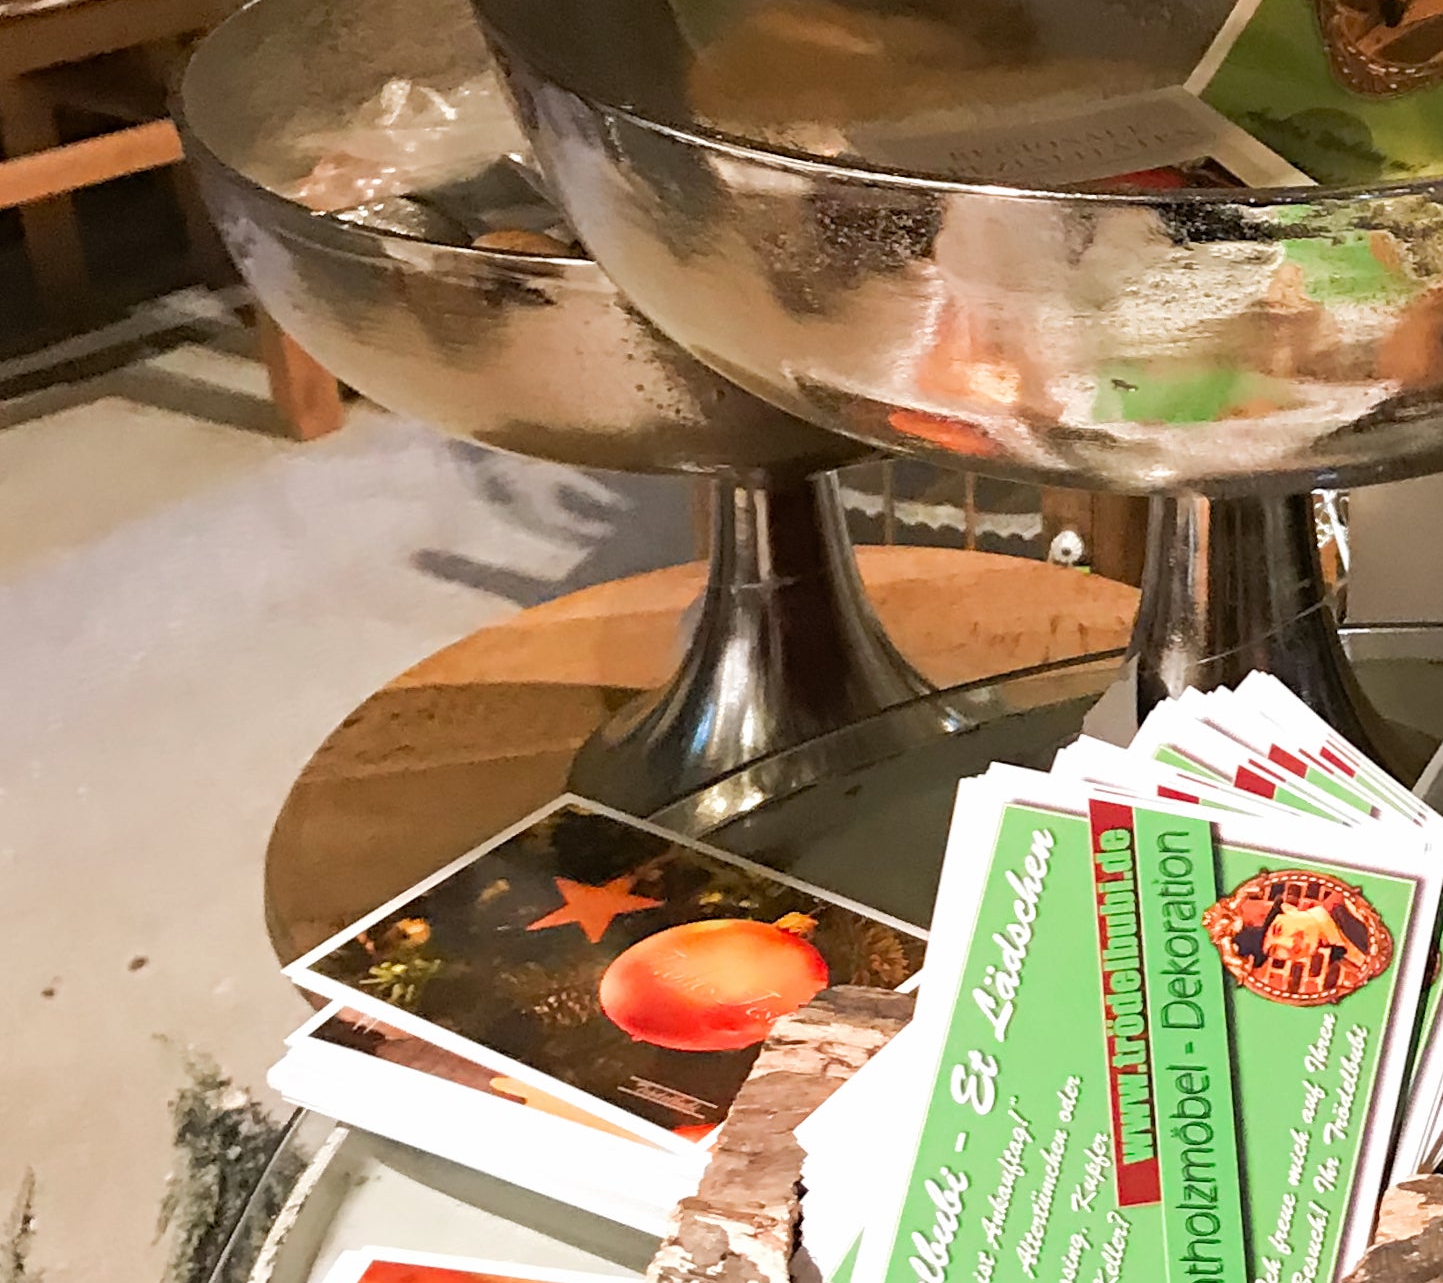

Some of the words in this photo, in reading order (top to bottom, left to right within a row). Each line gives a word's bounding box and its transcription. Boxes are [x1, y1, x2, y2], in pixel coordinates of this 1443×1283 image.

[972, 827, 1057, 1044] Lädschen
[1153, 829, 1205, 1031] Dekoration
[1096, 825, 1158, 1166] www.trödelbubi.de
[1304, 1012, 1337, 1073] Ihren
[951, 1049, 998, 1115] Et
[1301, 1079, 1326, 1124] auf
[1323, 1023, 1368, 1145] Trödelbubi
[1014, 1129, 1071, 1280] Altertümchen
[1057, 1074, 1083, 1125] oder
[1071, 1129, 1112, 1215] Kupfer
[1288, 1127, 1310, 1186] mich
[1313, 1156, 1341, 1194] Ihr
[1268, 1192, 1296, 1255] freue
